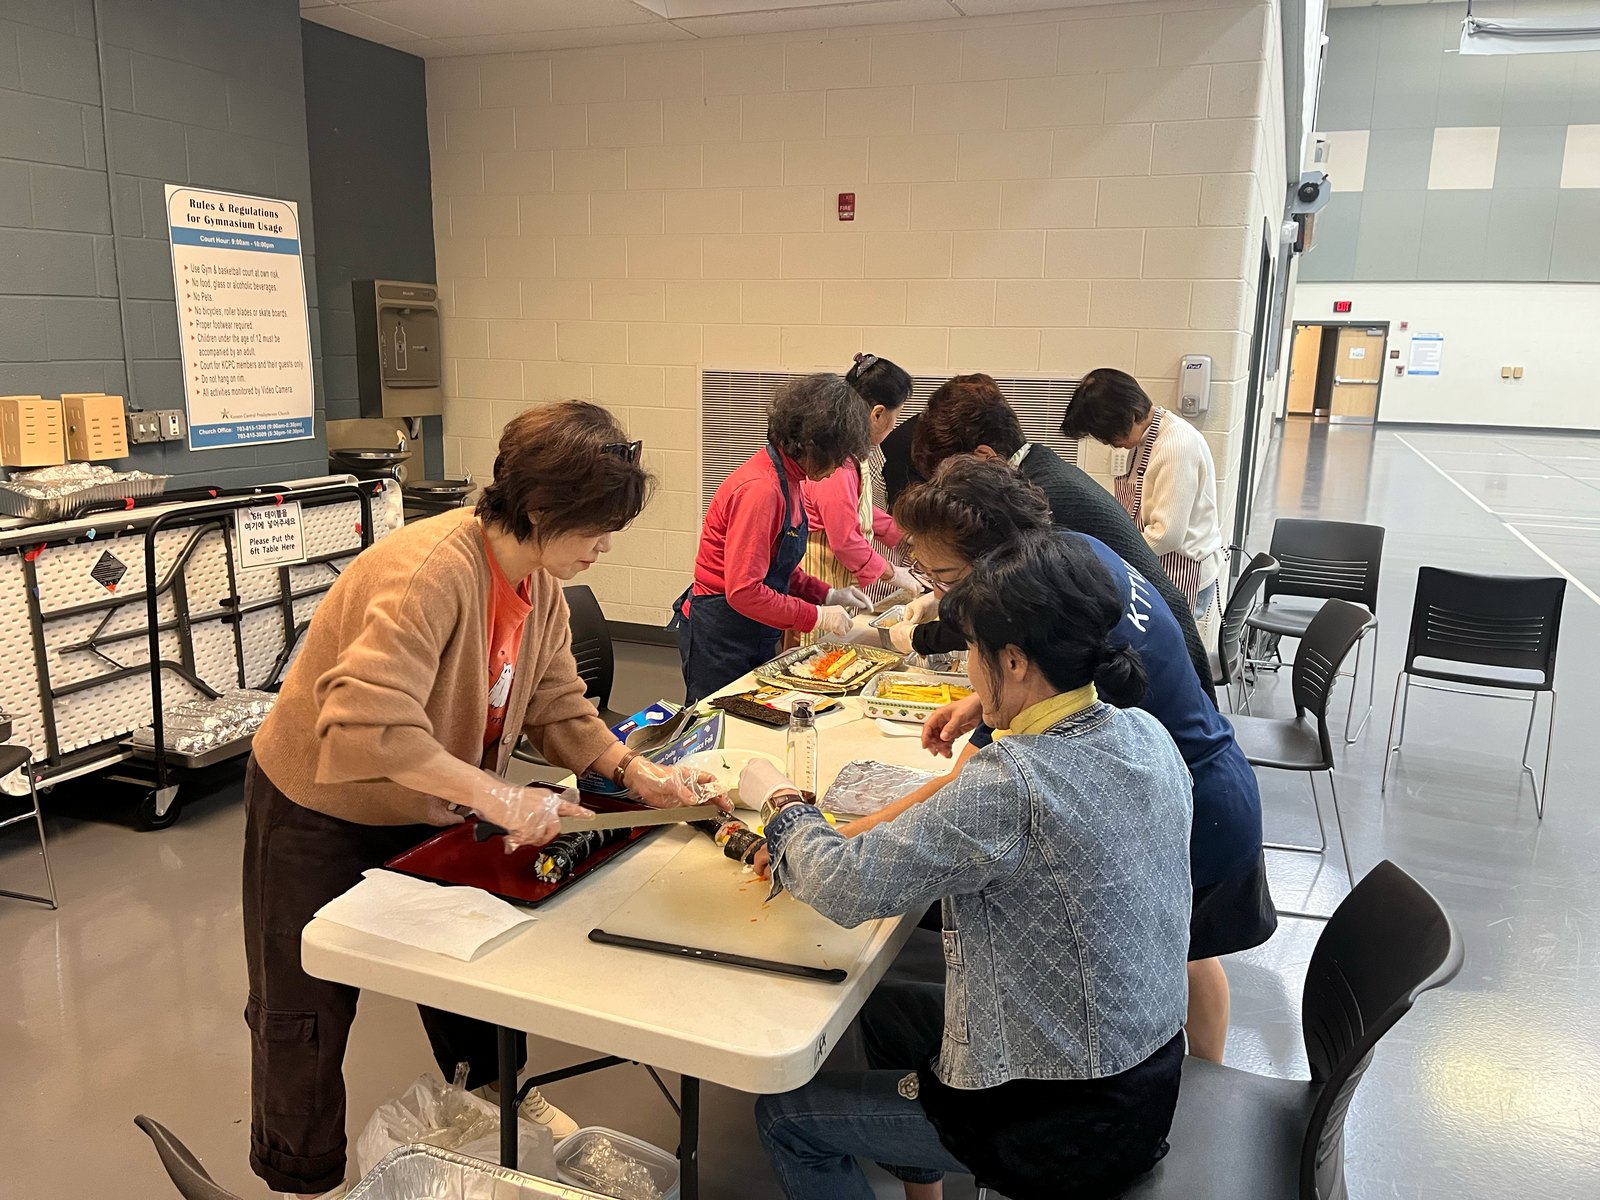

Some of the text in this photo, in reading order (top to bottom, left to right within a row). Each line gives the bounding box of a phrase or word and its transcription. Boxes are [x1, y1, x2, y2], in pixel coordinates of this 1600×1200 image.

[190, 199, 279, 218] Rules & Regulations
[187, 213, 283, 233] for Gymnasium Usage
[254, 241, 274, 249] 10:00pm
[191, 265, 200, 273] Use
[201, 264, 212, 275] Gym
[213, 266, 217, 274] &
[218, 267, 241, 276] basketball
[242, 269, 254, 277] court
[192, 278, 199, 287] No
[200, 279, 211, 289] food,
[213, 279, 225, 290] glass
[233, 281, 252, 289] alcoholic
[193, 292, 200, 300] No
[195, 306, 201, 314] No
[224, 307, 236, 315] roller
[238, 307, 251, 316] blades
[1337, 302, 1349, 311] EXIT
[196, 320, 211, 330] Proper
[213, 320, 232, 329] footwear
[197, 334, 217, 342] Children
[219, 334, 231, 342] under
[232, 334, 240, 342] the
[241, 336, 250, 345] age
[251, 334, 255, 342] of
[256, 334, 261, 342] 12
[275, 334, 280, 342] be
[199, 348, 229, 357] accompanied
[230, 348, 235, 357] by
[200, 361, 213, 369] Court
[222, 361, 235, 369] KCPC
[237, 360, 256, 368] members
[258, 360, 266, 368] and
[267, 360, 277, 368] their
[279, 360, 293, 370] guests
[202, 375, 208, 383] Do
[218, 374, 229, 384] hang
[210, 387, 230, 396] activities
[232, 386, 254, 395] monitored
[255, 386, 260, 396] by
[262, 386, 274, 394] Video
[265, 509, 287, 519] 테이블을
[245, 518, 295, 530] 여기에 넣어주세요
[250, 547, 259, 555] 6ft
[263, 545, 278, 553] Table
